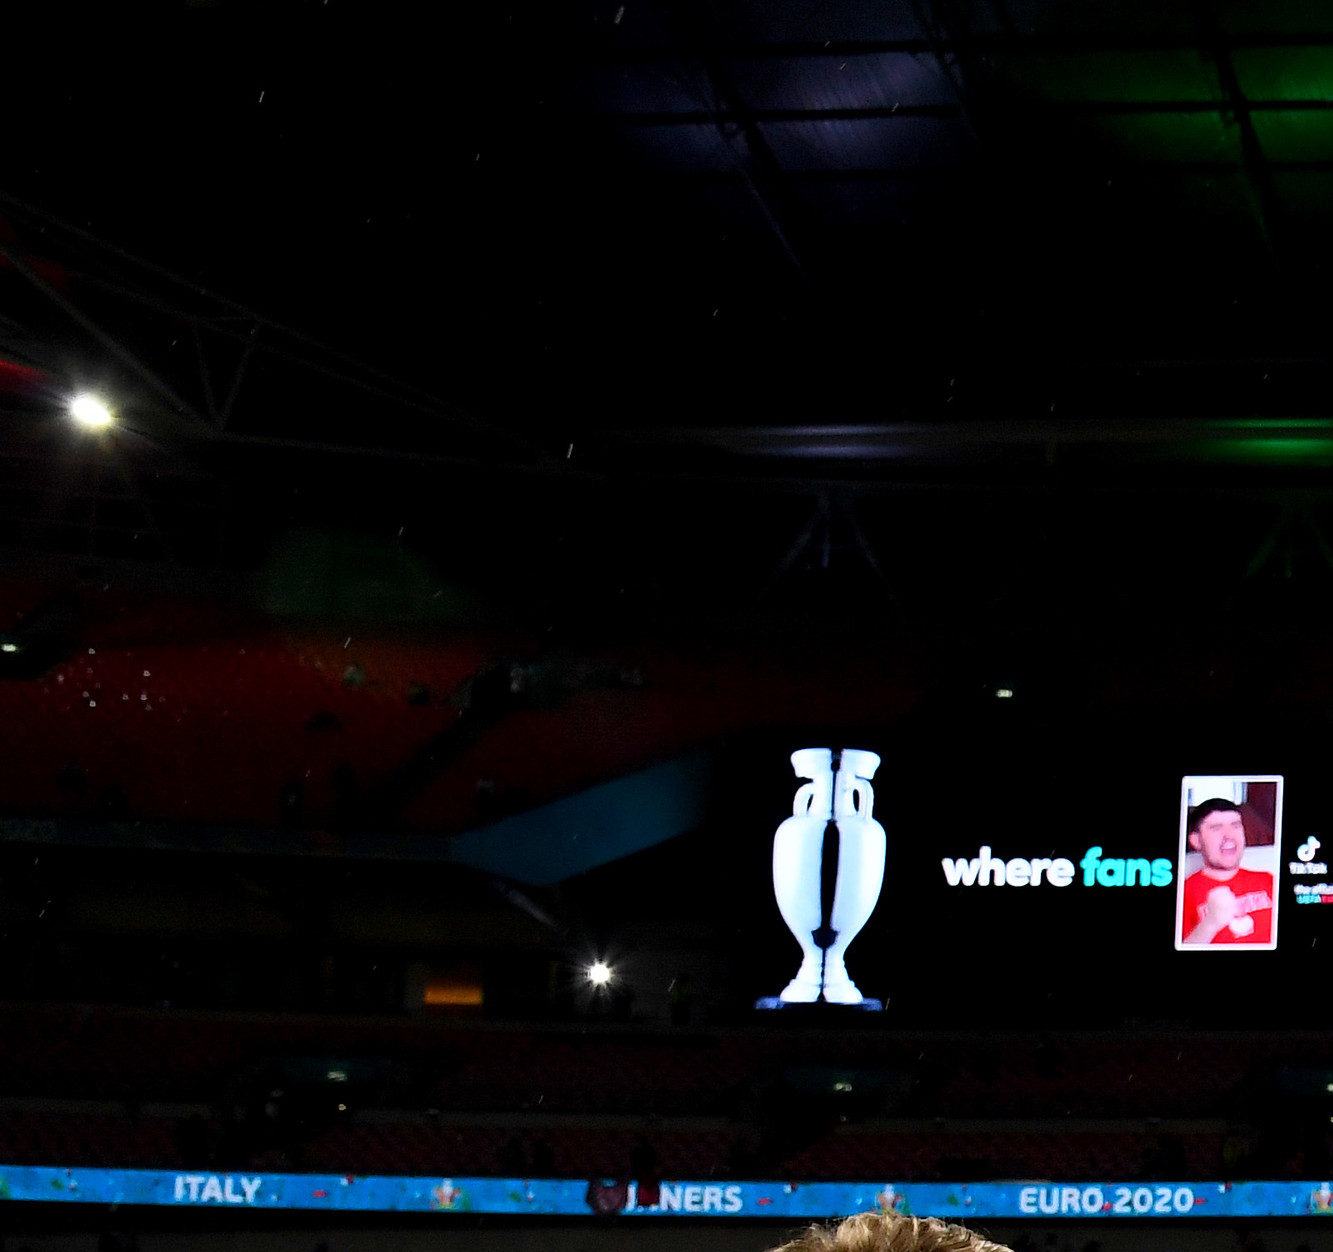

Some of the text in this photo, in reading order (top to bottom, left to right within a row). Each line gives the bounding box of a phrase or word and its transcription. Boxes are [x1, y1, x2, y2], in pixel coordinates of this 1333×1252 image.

[941, 845, 1173, 887] where fans
[174, 1175, 262, 1204] ITALY
[1019, 1187, 1194, 1215] EURO 2020
